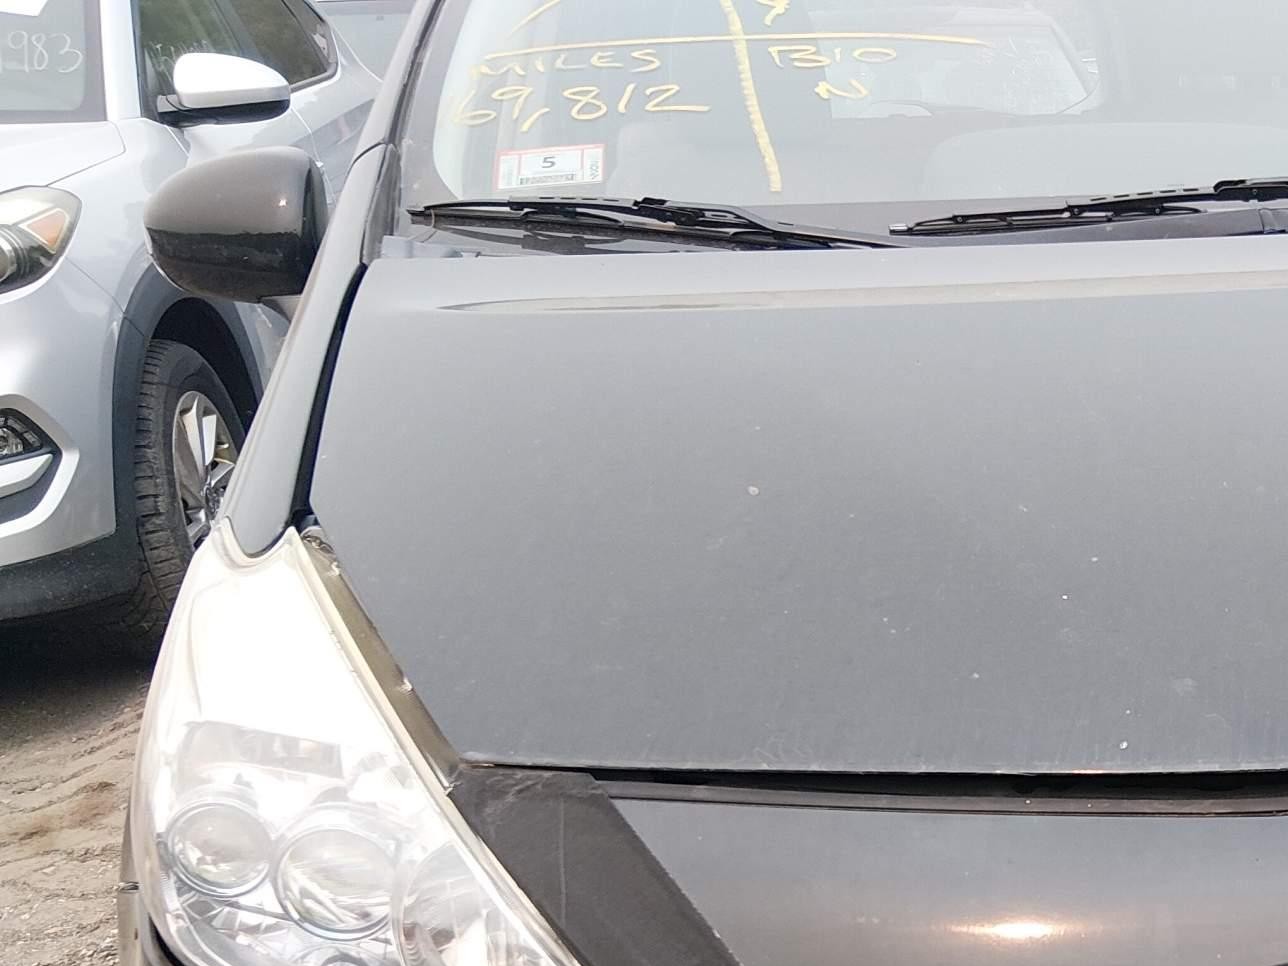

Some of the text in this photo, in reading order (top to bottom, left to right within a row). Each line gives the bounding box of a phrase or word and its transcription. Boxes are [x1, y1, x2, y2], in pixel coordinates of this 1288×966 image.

[0, 30, 84, 73] 983
[470, 49, 661, 77] MILES
[453, 82, 711, 133] 69,812
[541, 156, 556, 169] 5
